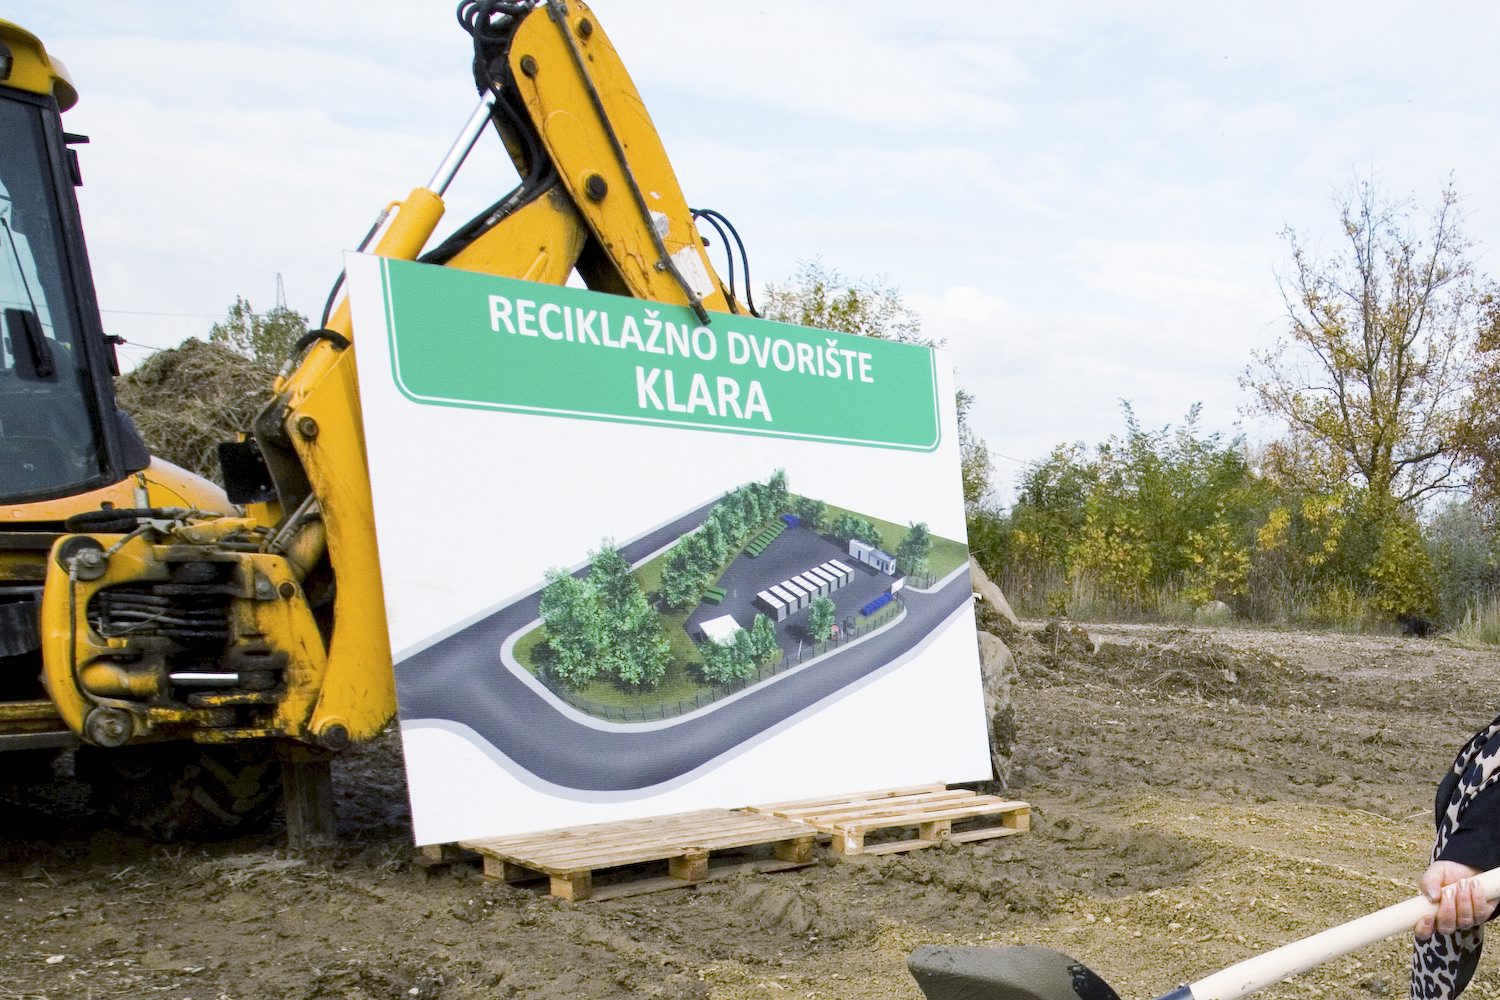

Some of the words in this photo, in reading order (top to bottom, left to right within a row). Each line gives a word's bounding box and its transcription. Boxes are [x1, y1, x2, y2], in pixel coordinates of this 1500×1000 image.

[488, 294, 717, 361] RECIKLAŽNO
[727, 331, 874, 384] DVORIŠTE
[635, 366, 773, 422] KLARA
